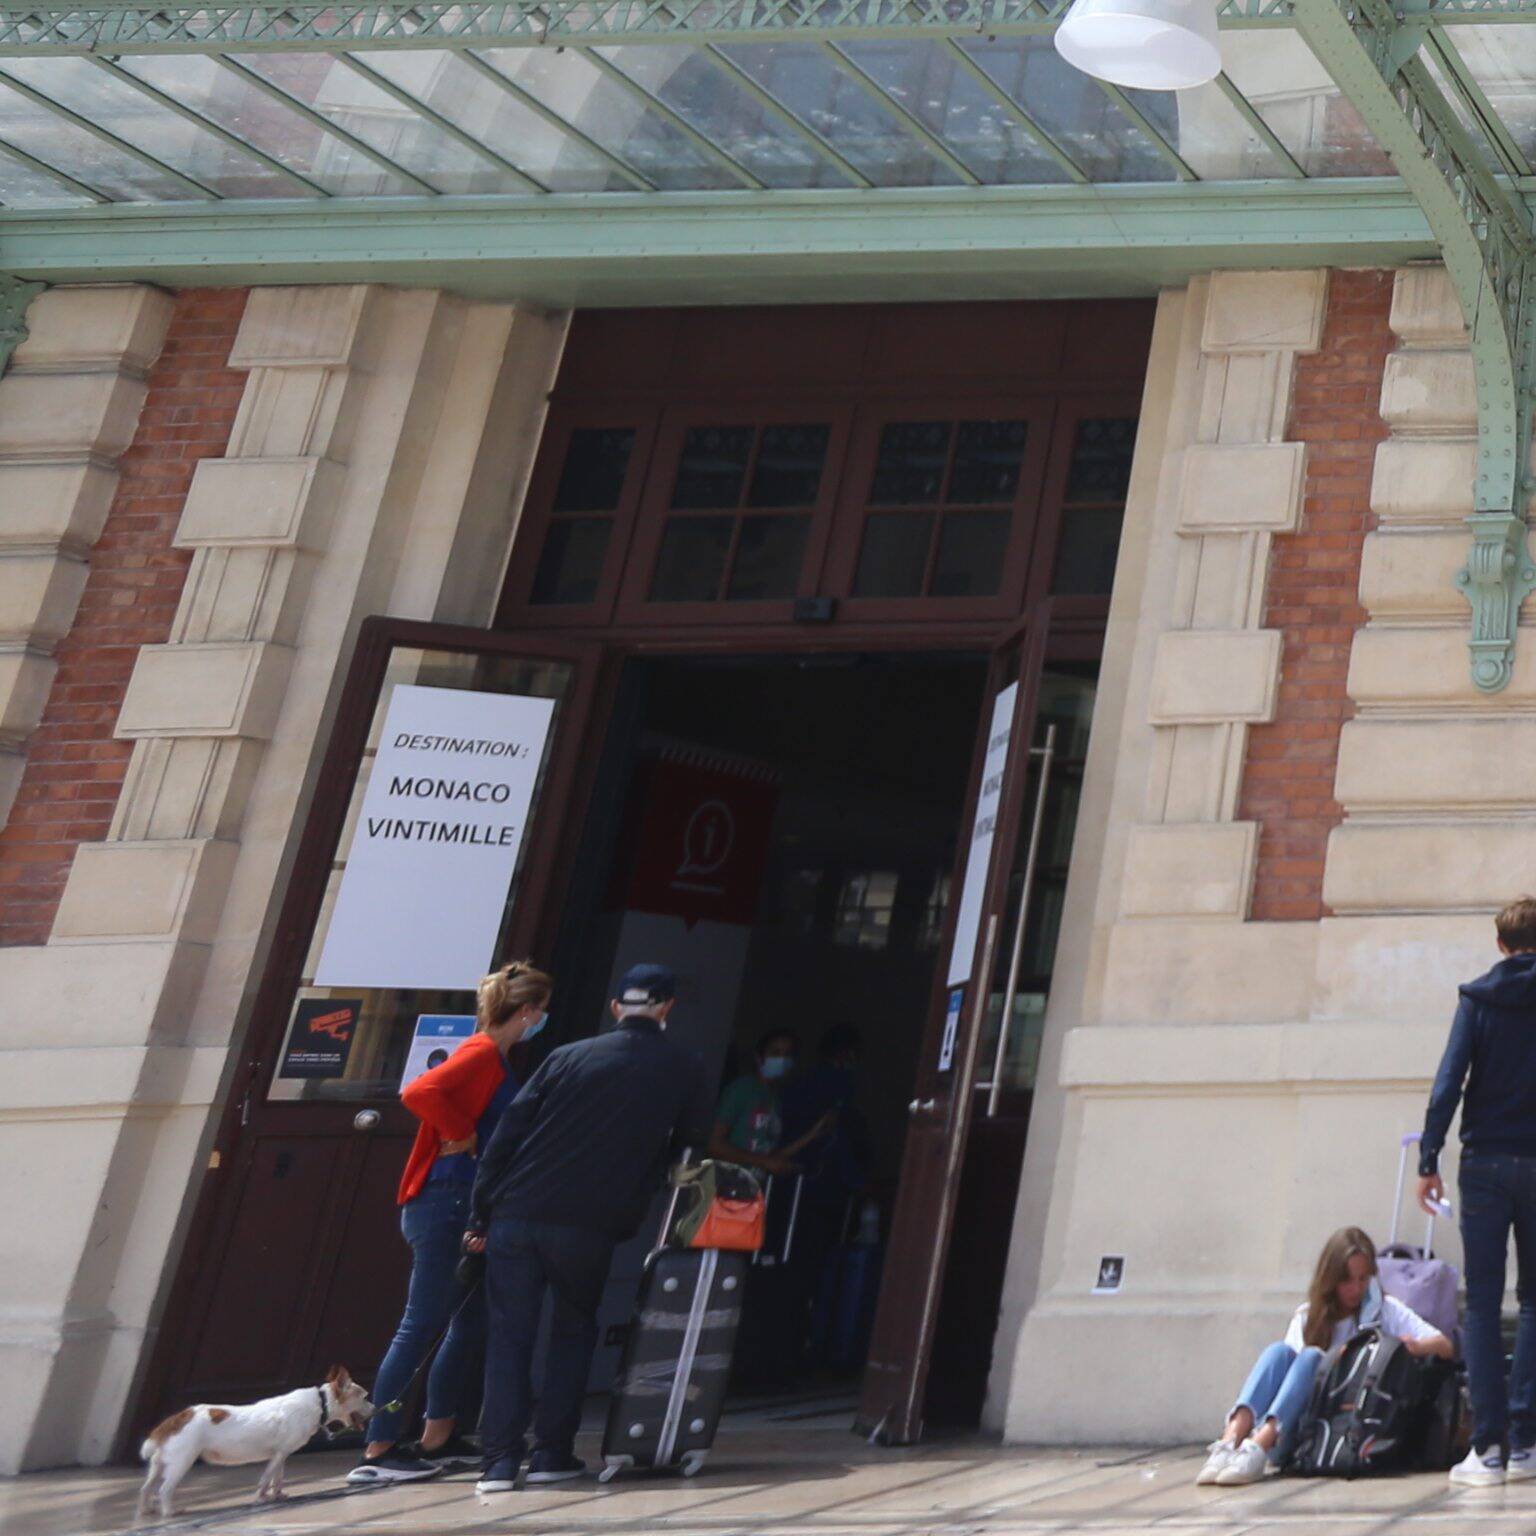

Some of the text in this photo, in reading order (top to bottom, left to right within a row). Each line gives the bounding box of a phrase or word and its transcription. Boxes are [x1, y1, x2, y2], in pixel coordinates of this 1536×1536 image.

[393, 733, 521, 758] DESTINATION
[389, 776, 511, 804] MONACO
[366, 817, 515, 846] VINTIMILLE
